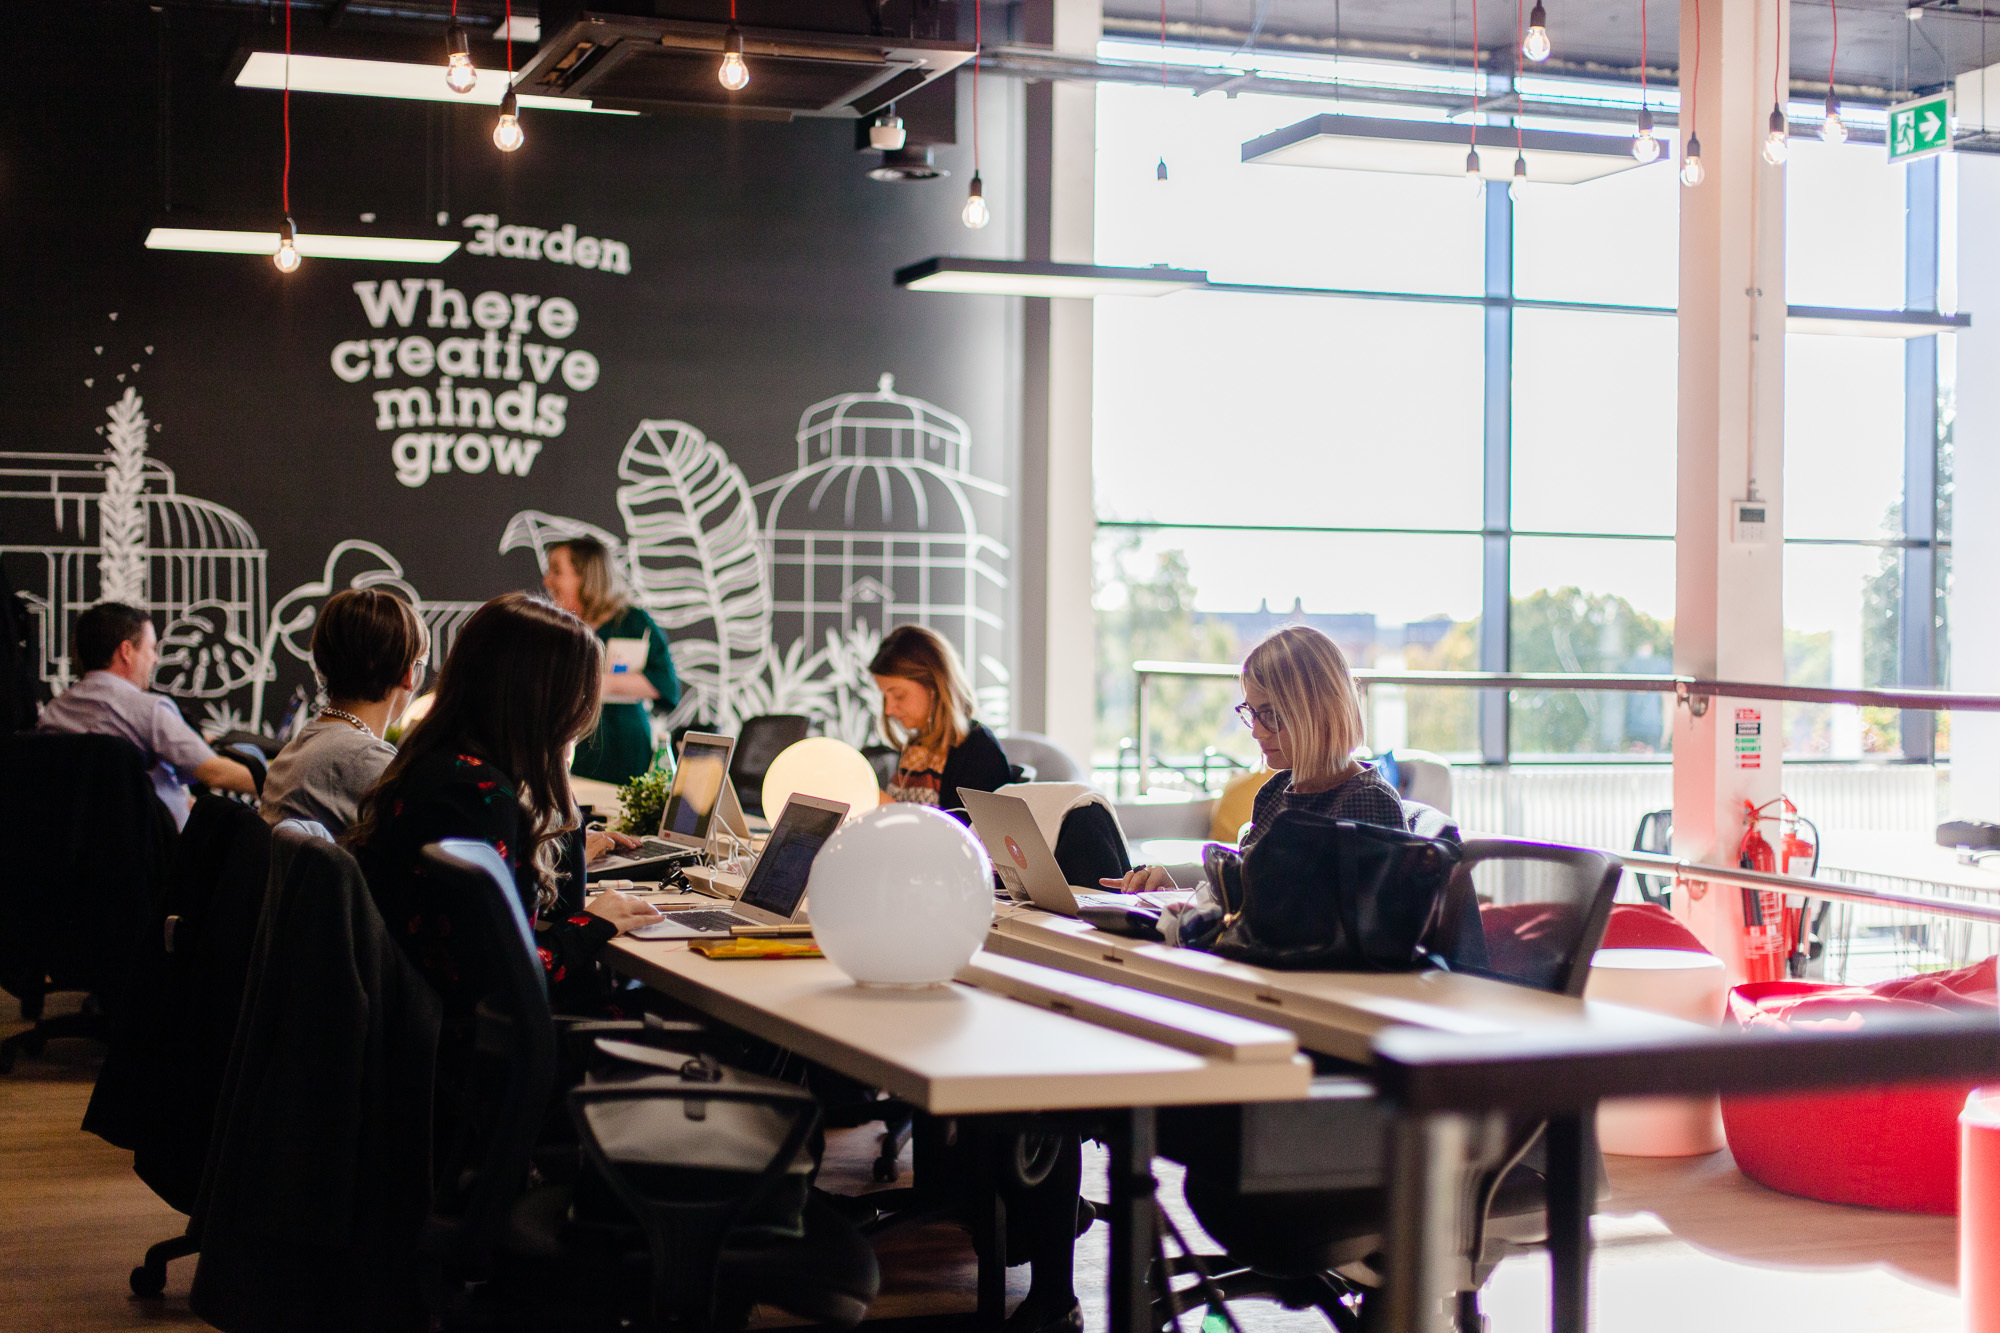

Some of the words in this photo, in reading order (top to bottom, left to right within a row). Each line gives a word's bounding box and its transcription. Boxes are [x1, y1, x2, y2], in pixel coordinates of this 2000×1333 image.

[353, 278, 579, 339] Where
[330, 329, 600, 391] creative
[372, 376, 569, 437] minds
[391, 432, 543, 488] grow
